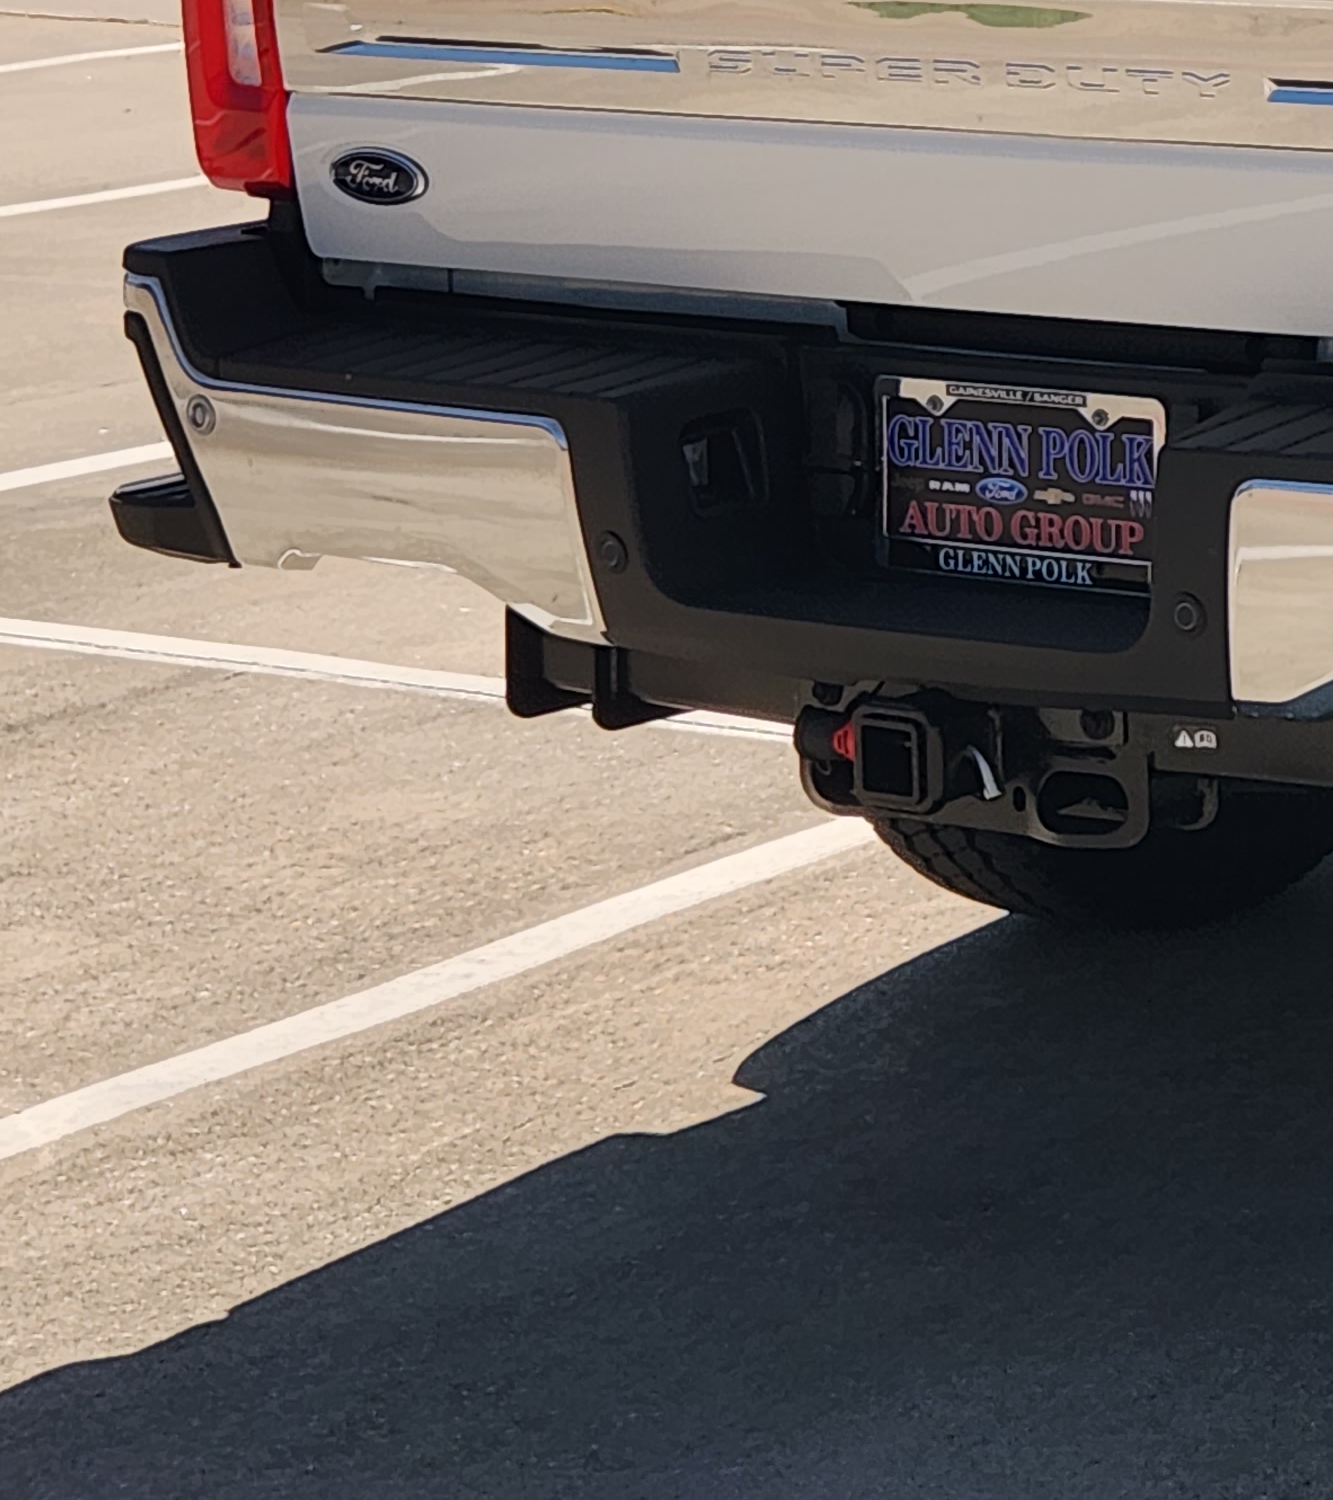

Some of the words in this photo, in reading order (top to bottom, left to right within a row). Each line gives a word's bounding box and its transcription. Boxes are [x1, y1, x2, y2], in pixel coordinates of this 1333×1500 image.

[706, 50, 981, 88] SUPER
[1004, 61, 1231, 98] DUTY
[347, 159, 399, 194] Ford
[888, 414, 1032, 477] GLENN
[1039, 426, 1155, 487] POLK
[928, 479, 971, 494] RAM
[899, 500, 1003, 542] AUTO
[1010, 510, 1145, 555] GROUP
[938, 548, 1025, 578] GLENN
[1025, 557, 1093, 585] POLK
